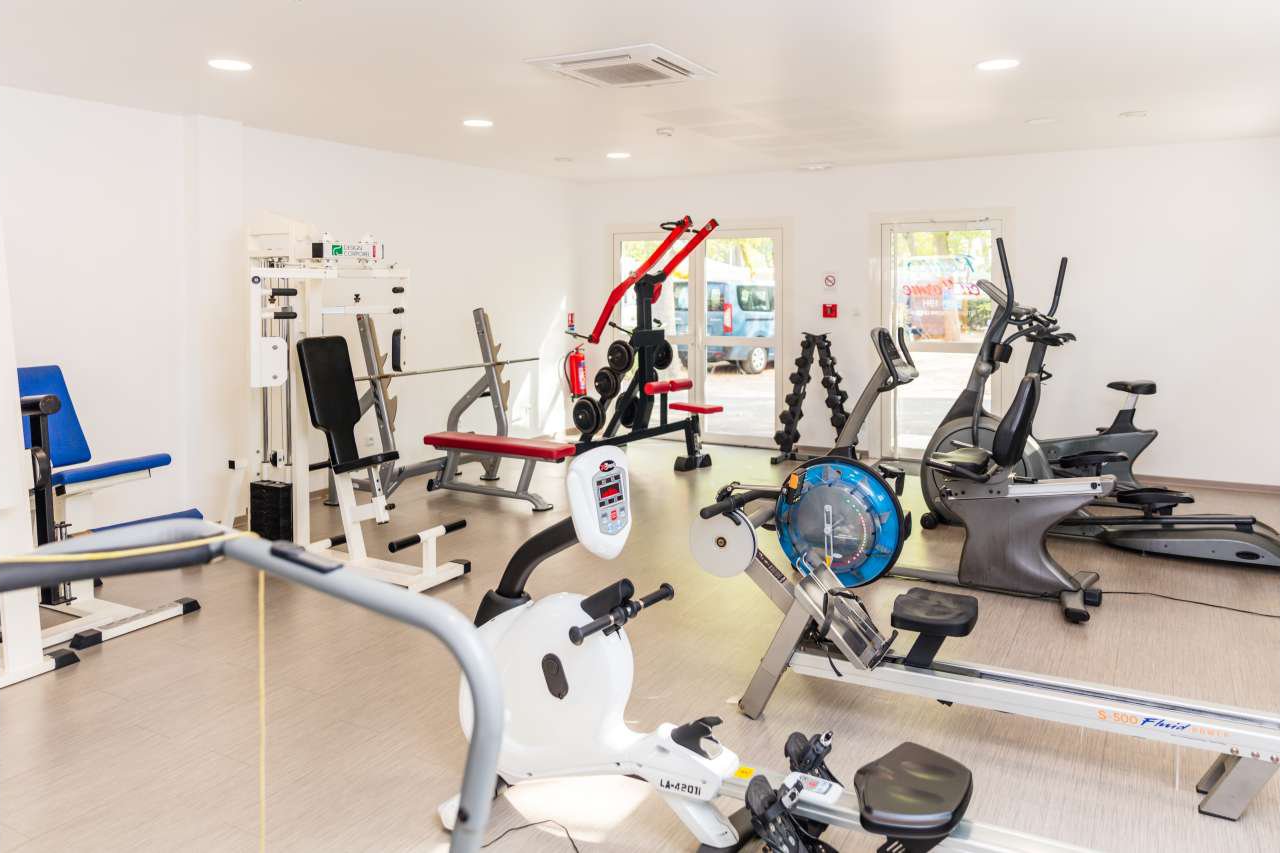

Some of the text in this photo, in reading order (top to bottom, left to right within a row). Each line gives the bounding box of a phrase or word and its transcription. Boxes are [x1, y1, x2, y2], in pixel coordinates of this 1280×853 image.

[1097, 709, 1191, 731] S 500 Fluid
